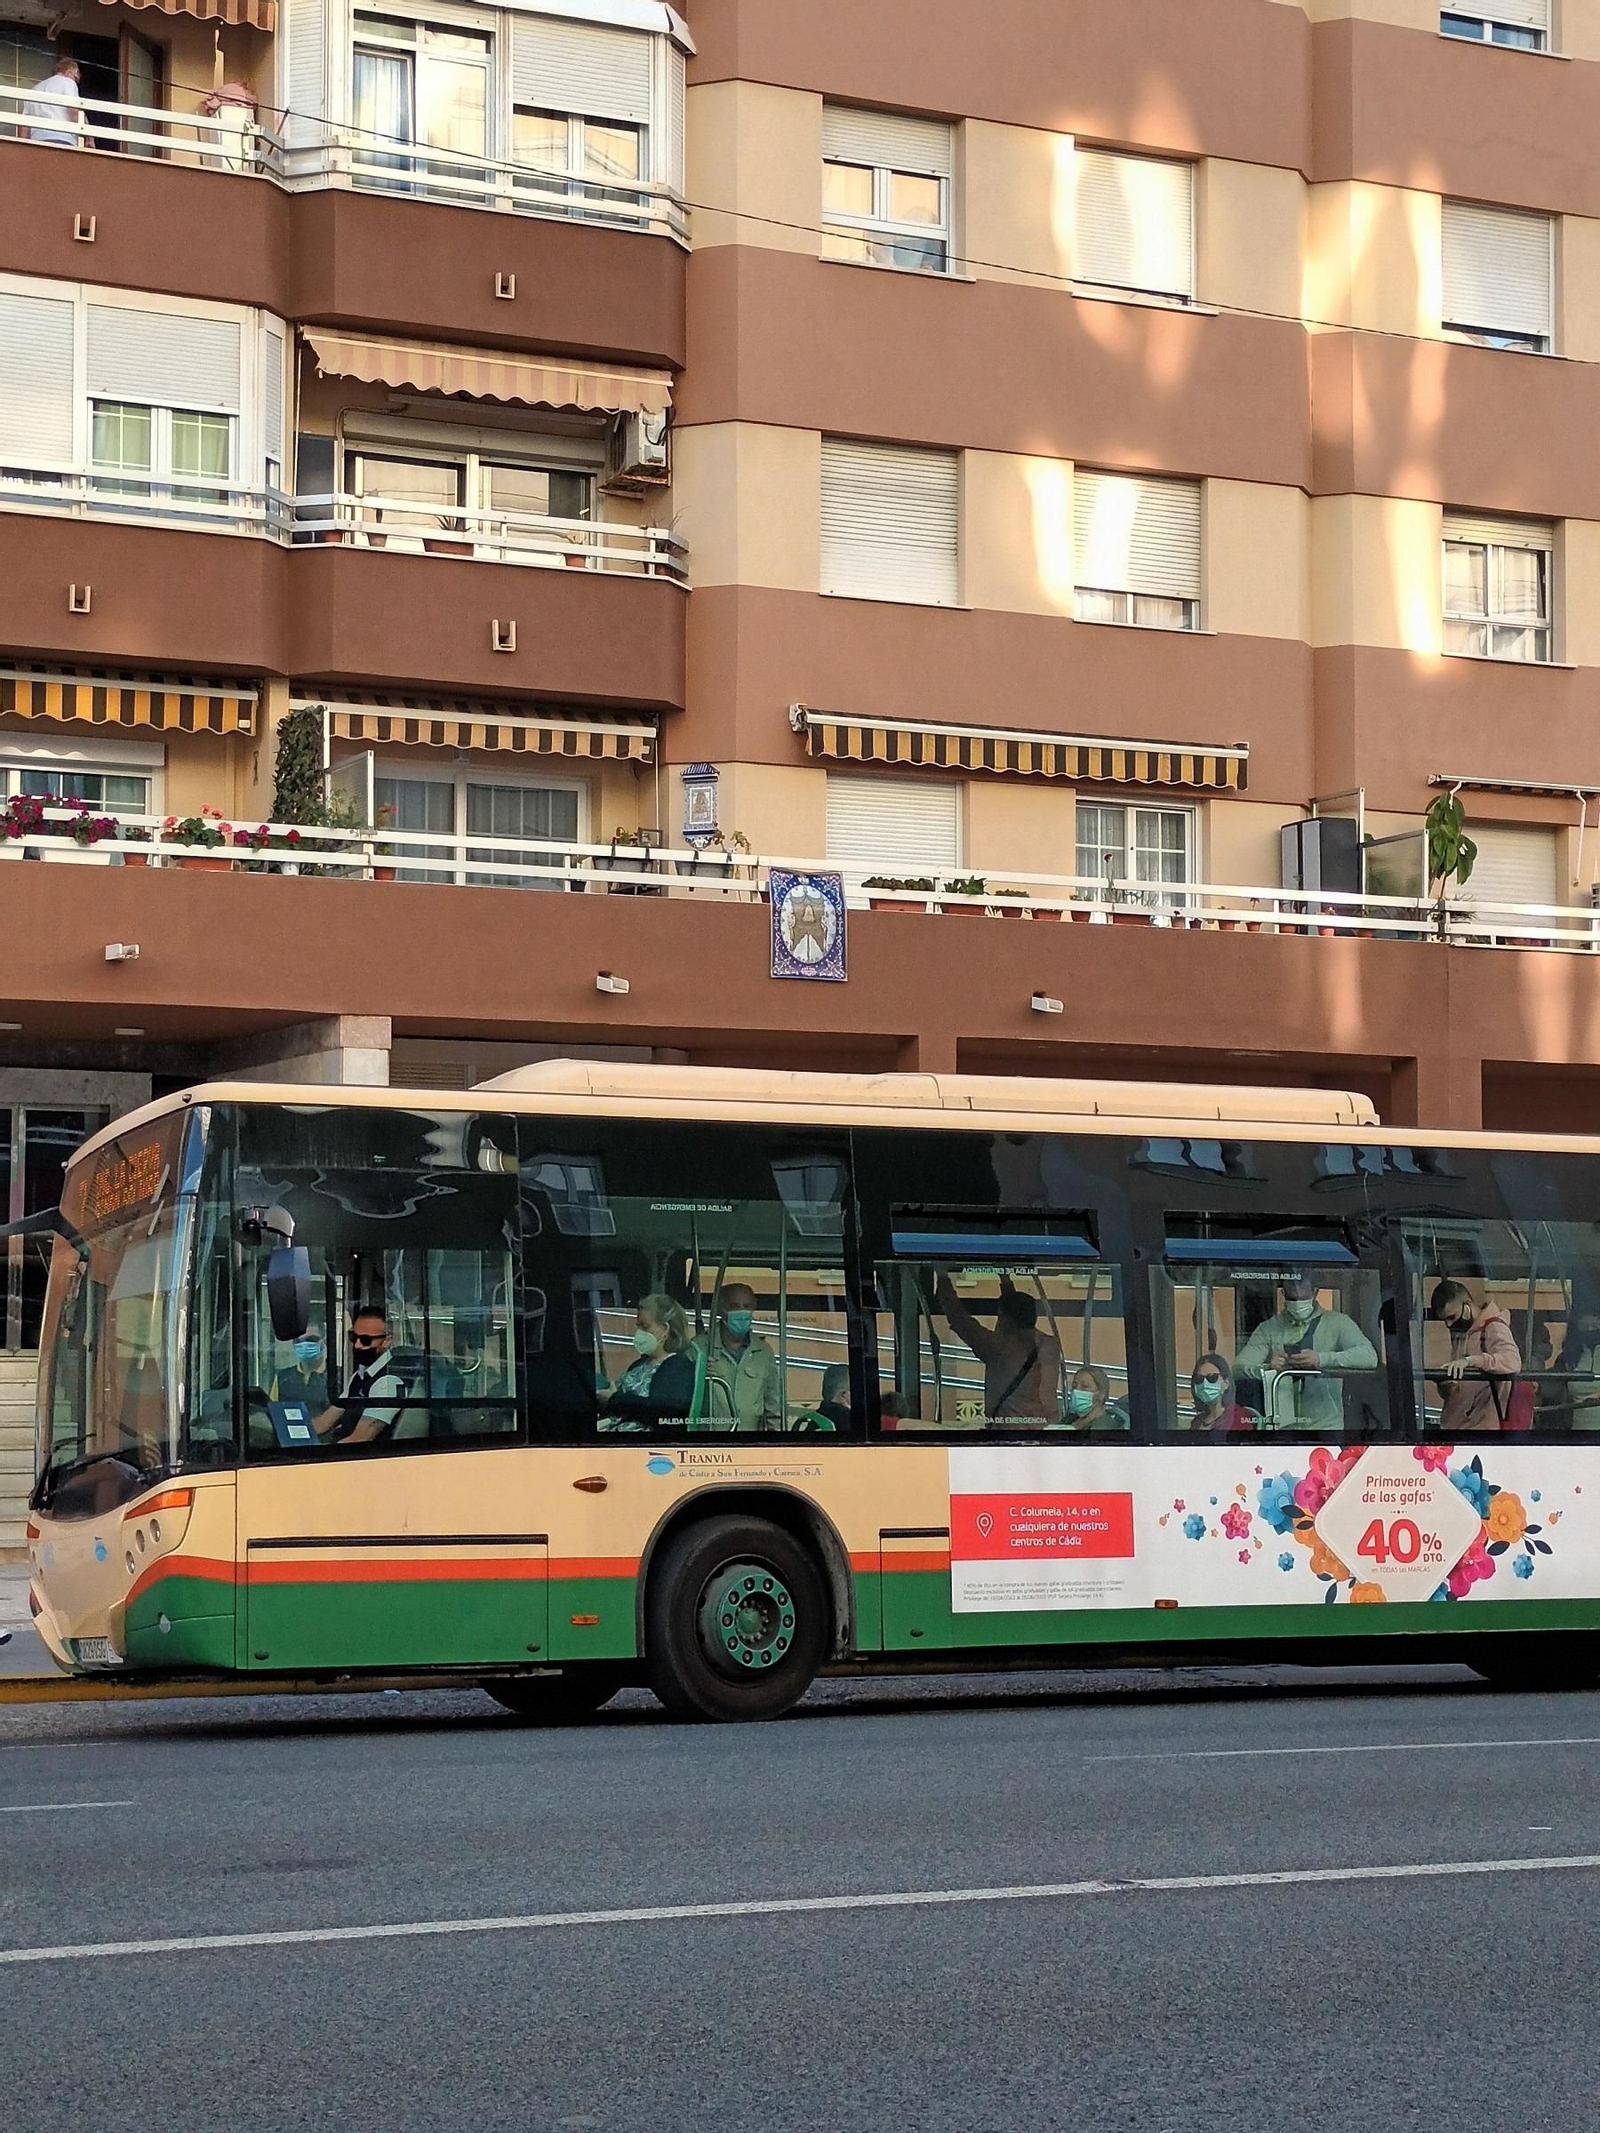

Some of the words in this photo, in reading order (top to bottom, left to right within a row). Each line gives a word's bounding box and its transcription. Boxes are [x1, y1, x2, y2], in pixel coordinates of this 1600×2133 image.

[658, 1417, 684, 1425] SALIDA
[1366, 1475, 1426, 1488] Primavera
[1362, 1491, 1376, 1503] de
[1379, 1490, 1396, 1503] las
[1020, 1506, 1064, 1518] Columela,
[1089, 1507, 1101, 1516] en
[1009, 1521, 1056, 1533] cualquiera
[1057, 1520, 1069, 1531] de
[1071, 1521, 1109, 1531] nuestros
[1010, 1537, 1043, 1547] centros
[1045, 1536, 1057, 1546] de
[1423, 1553, 1446, 1563] DTO.
